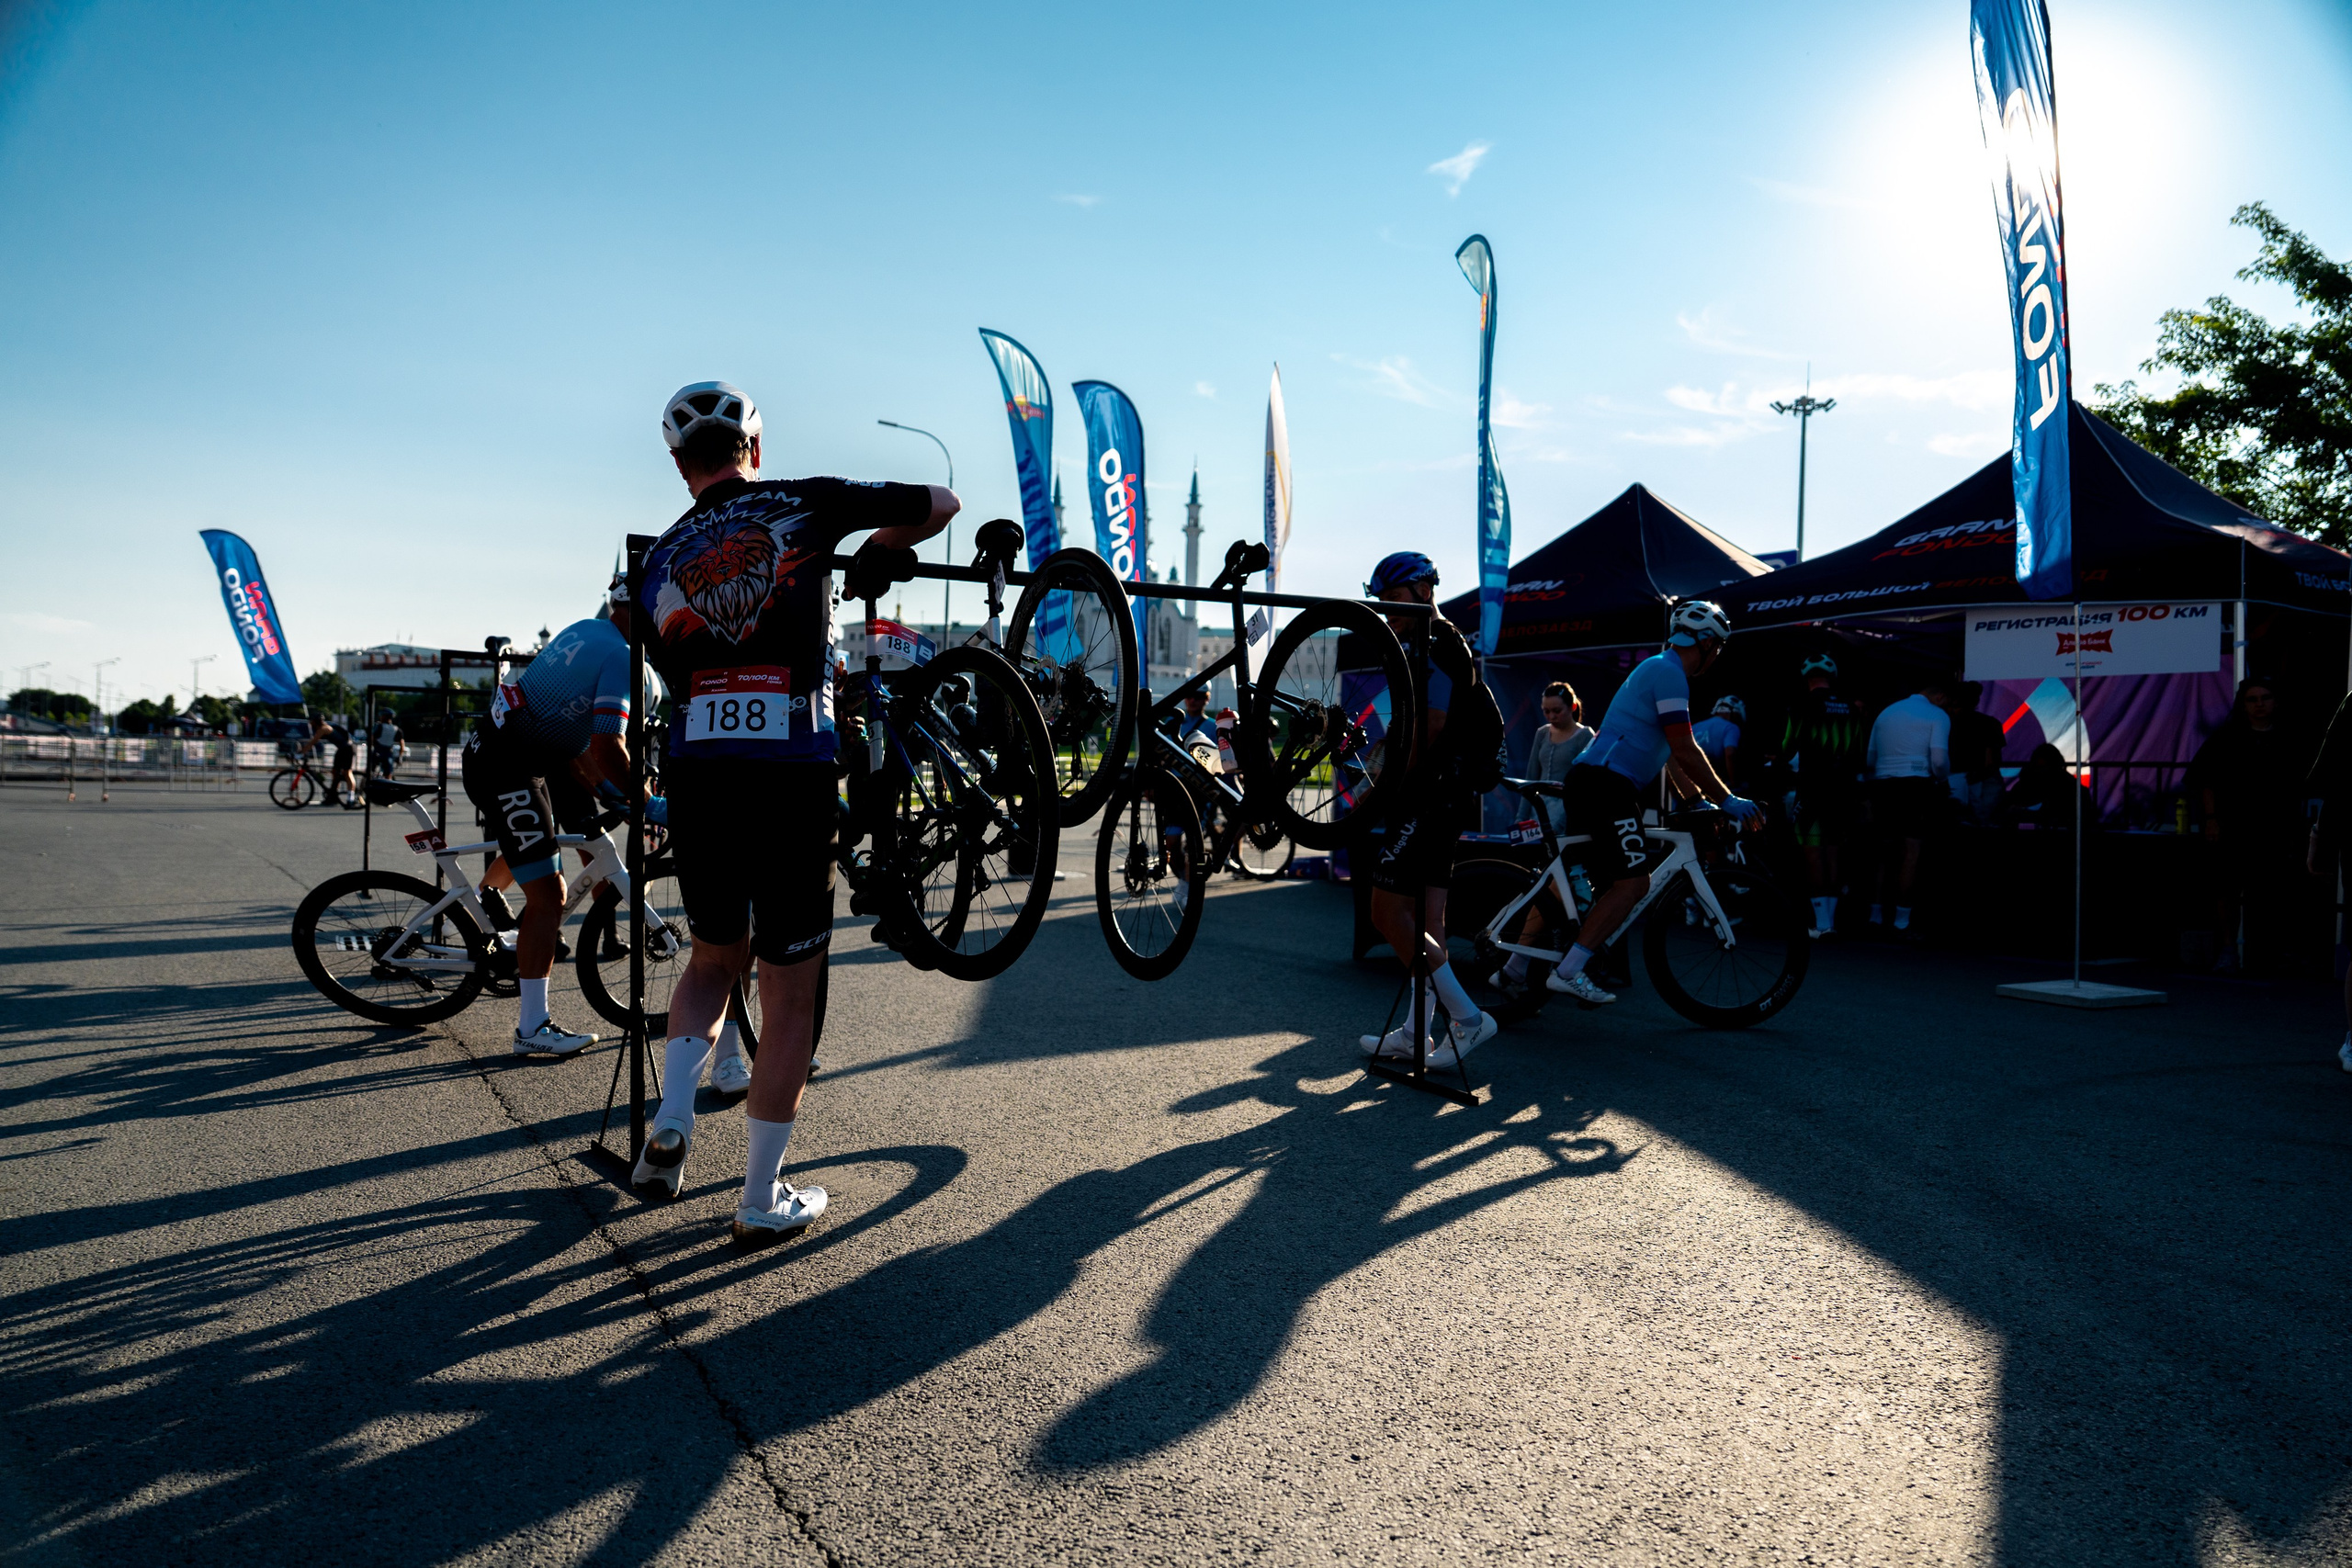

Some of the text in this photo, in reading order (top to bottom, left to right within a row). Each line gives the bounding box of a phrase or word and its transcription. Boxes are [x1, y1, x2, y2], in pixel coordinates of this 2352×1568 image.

[722, 491, 803, 507] TEAM
[1894, 517, 2018, 547] GRAN
[1746, 594, 1803, 613] ТВОЙ
[1806, 581, 1933, 606] БОЛЬШОЙ
[1250, 614, 1259, 626] 31
[1974, 604, 2209, 632] РЕГИСТРАЦИЯ 100 КМ
[553, 631, 586, 666] CA
[888, 636, 910, 654] 188
[919, 645, 933, 661] B
[540, 647, 560, 667] EAM
[700, 678, 729, 686] FONDO
[738, 673, 768, 682] 70/100
[560, 694, 594, 721] RCA
[706, 698, 766, 732] 188
[497, 788, 545, 852] RCA
[431, 837, 442, 845] A
[1510, 829, 1521, 840] B
[1525, 829, 1541, 839] 164
[1613, 817, 1647, 869] RCA
[410, 841, 427, 852] 158
[1758, 974, 1795, 1012] DT SWISS
